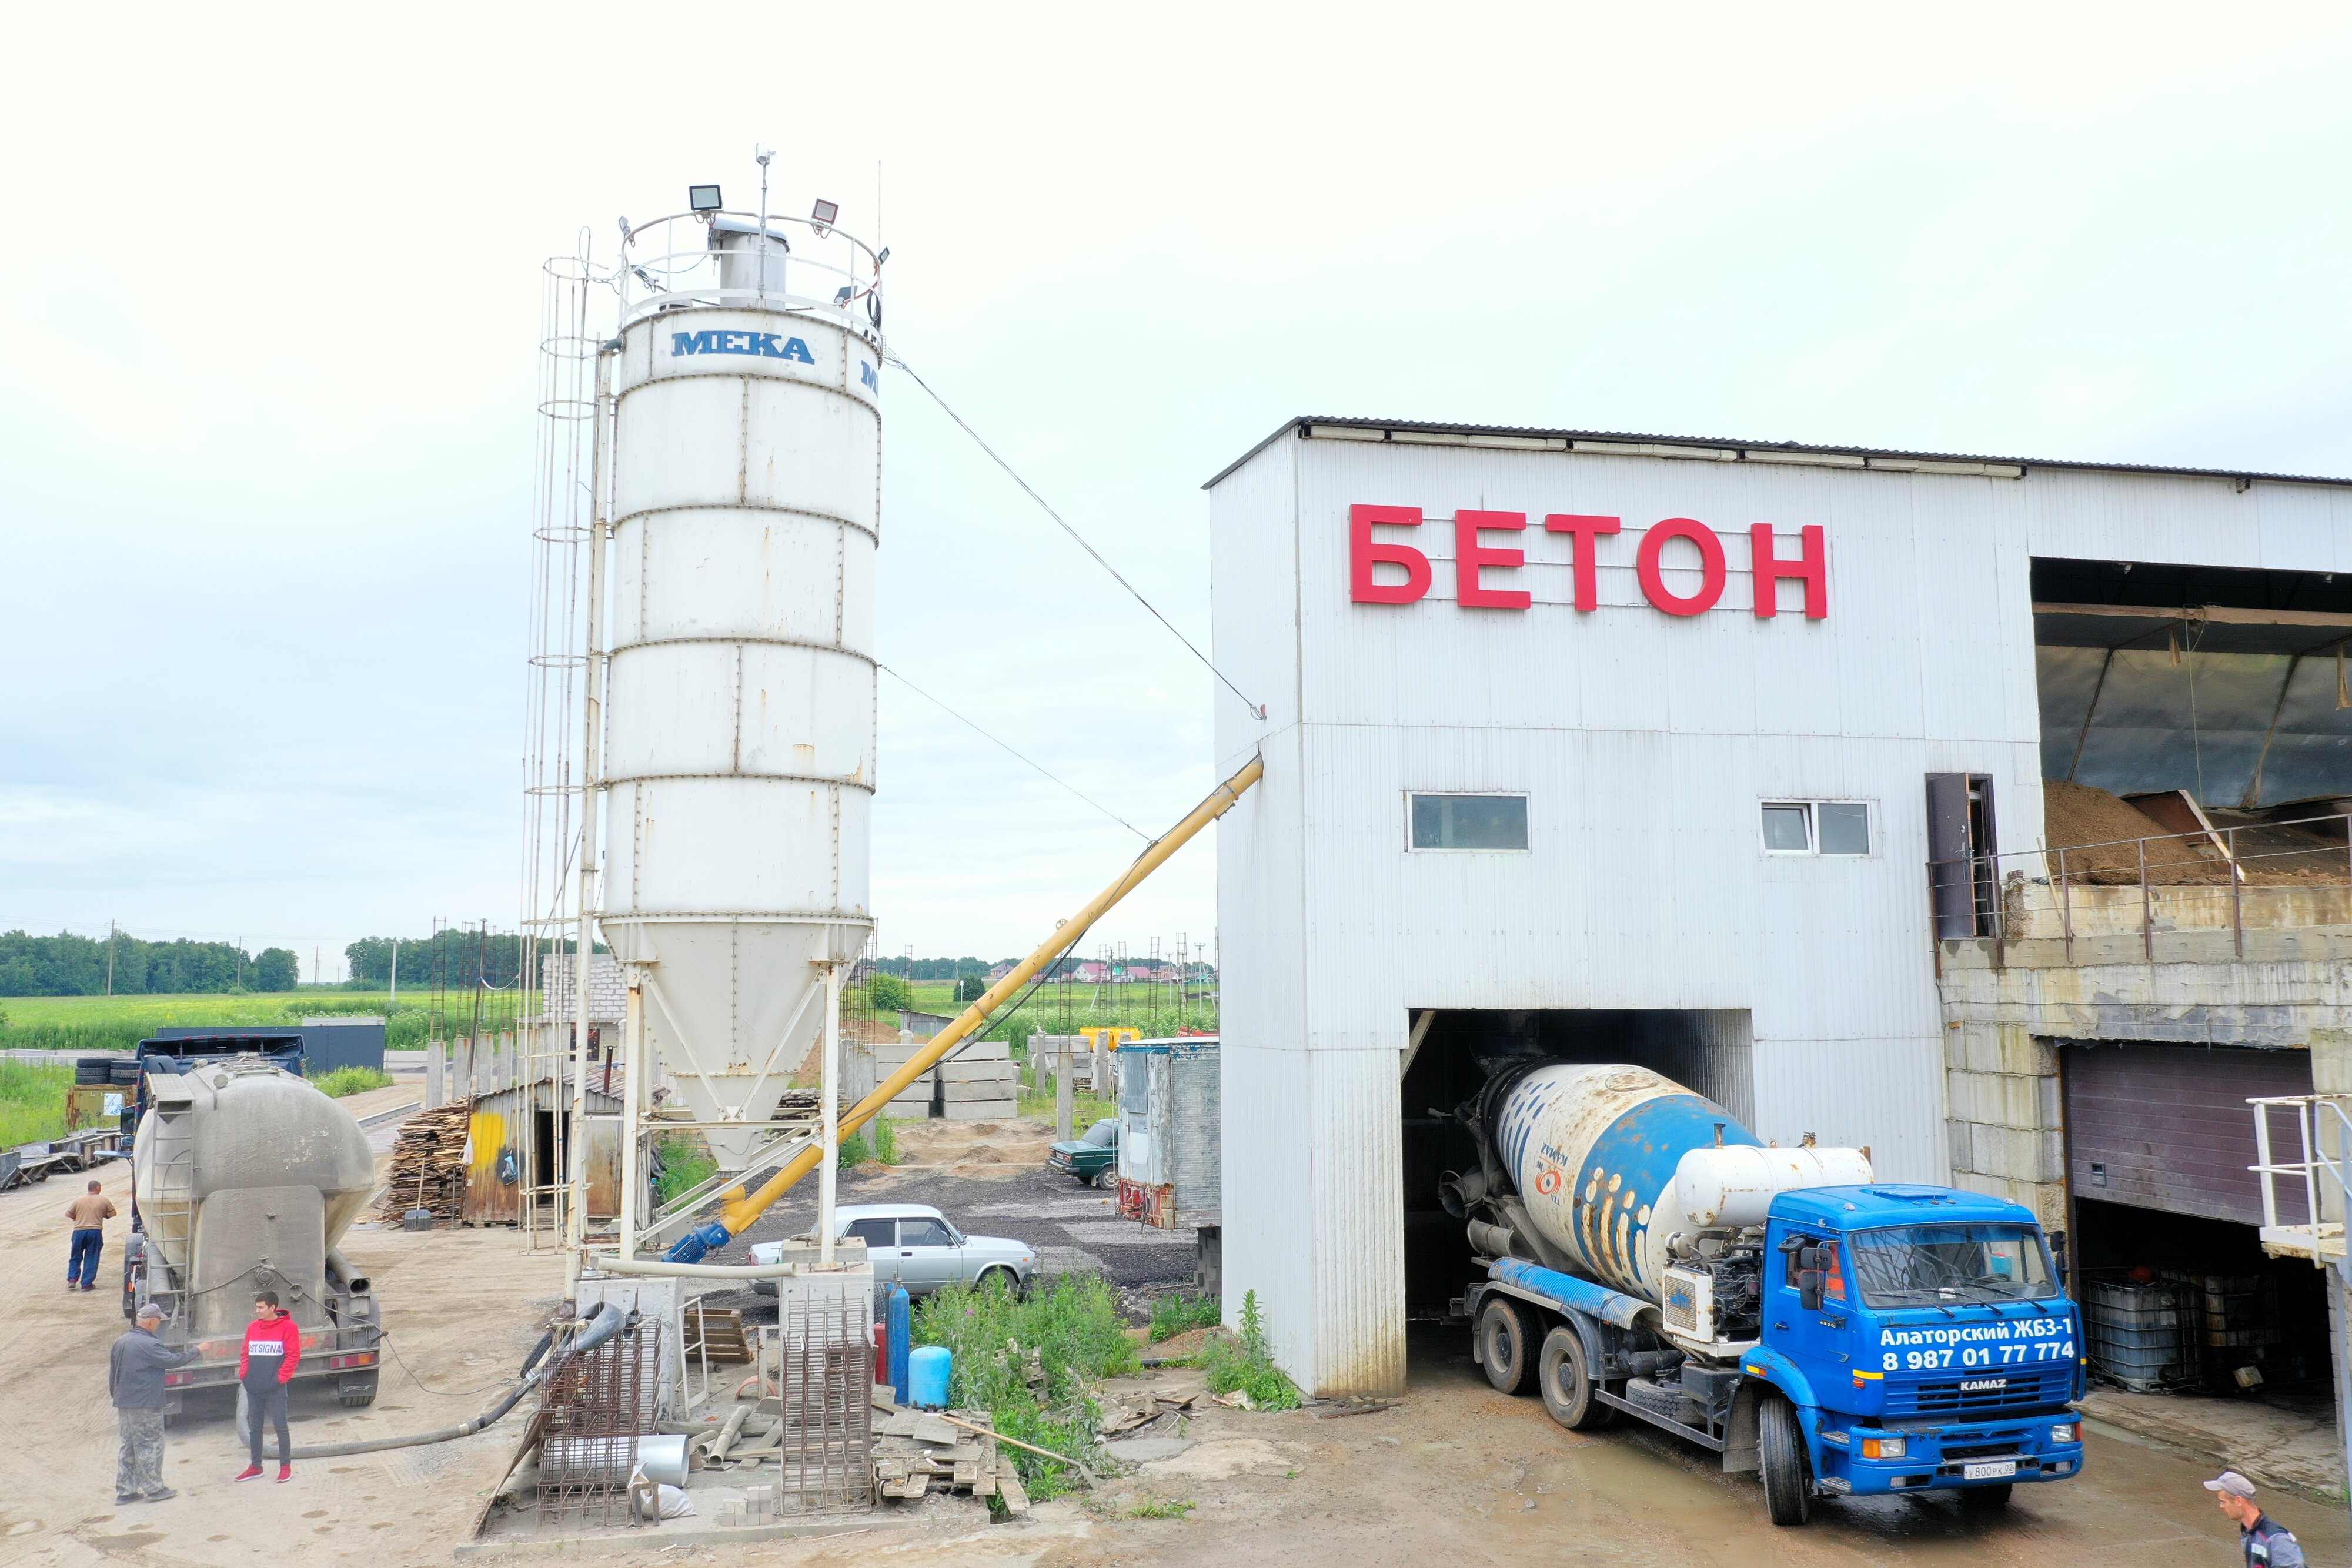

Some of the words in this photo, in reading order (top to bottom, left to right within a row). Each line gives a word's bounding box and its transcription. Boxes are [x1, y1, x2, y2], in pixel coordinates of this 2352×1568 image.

[671, 330, 815, 365] MEKA
[1349, 503, 1828, 620] БЕТОН
[1880, 1322, 2009, 1346] Алаторский
[2013, 1318, 2072, 1338] ЖБЗ-1
[259, 1344, 283, 1353] SIGNAL
[1883, 1352, 1899, 1371] 8
[1907, 1349, 1954, 1369] 987
[1962, 1348, 1990, 1366] 01
[1999, 1345, 2027, 1363] 77
[2034, 1340, 2074, 1360] 774
[1960, 1379, 2006, 1391] KAMAZ
